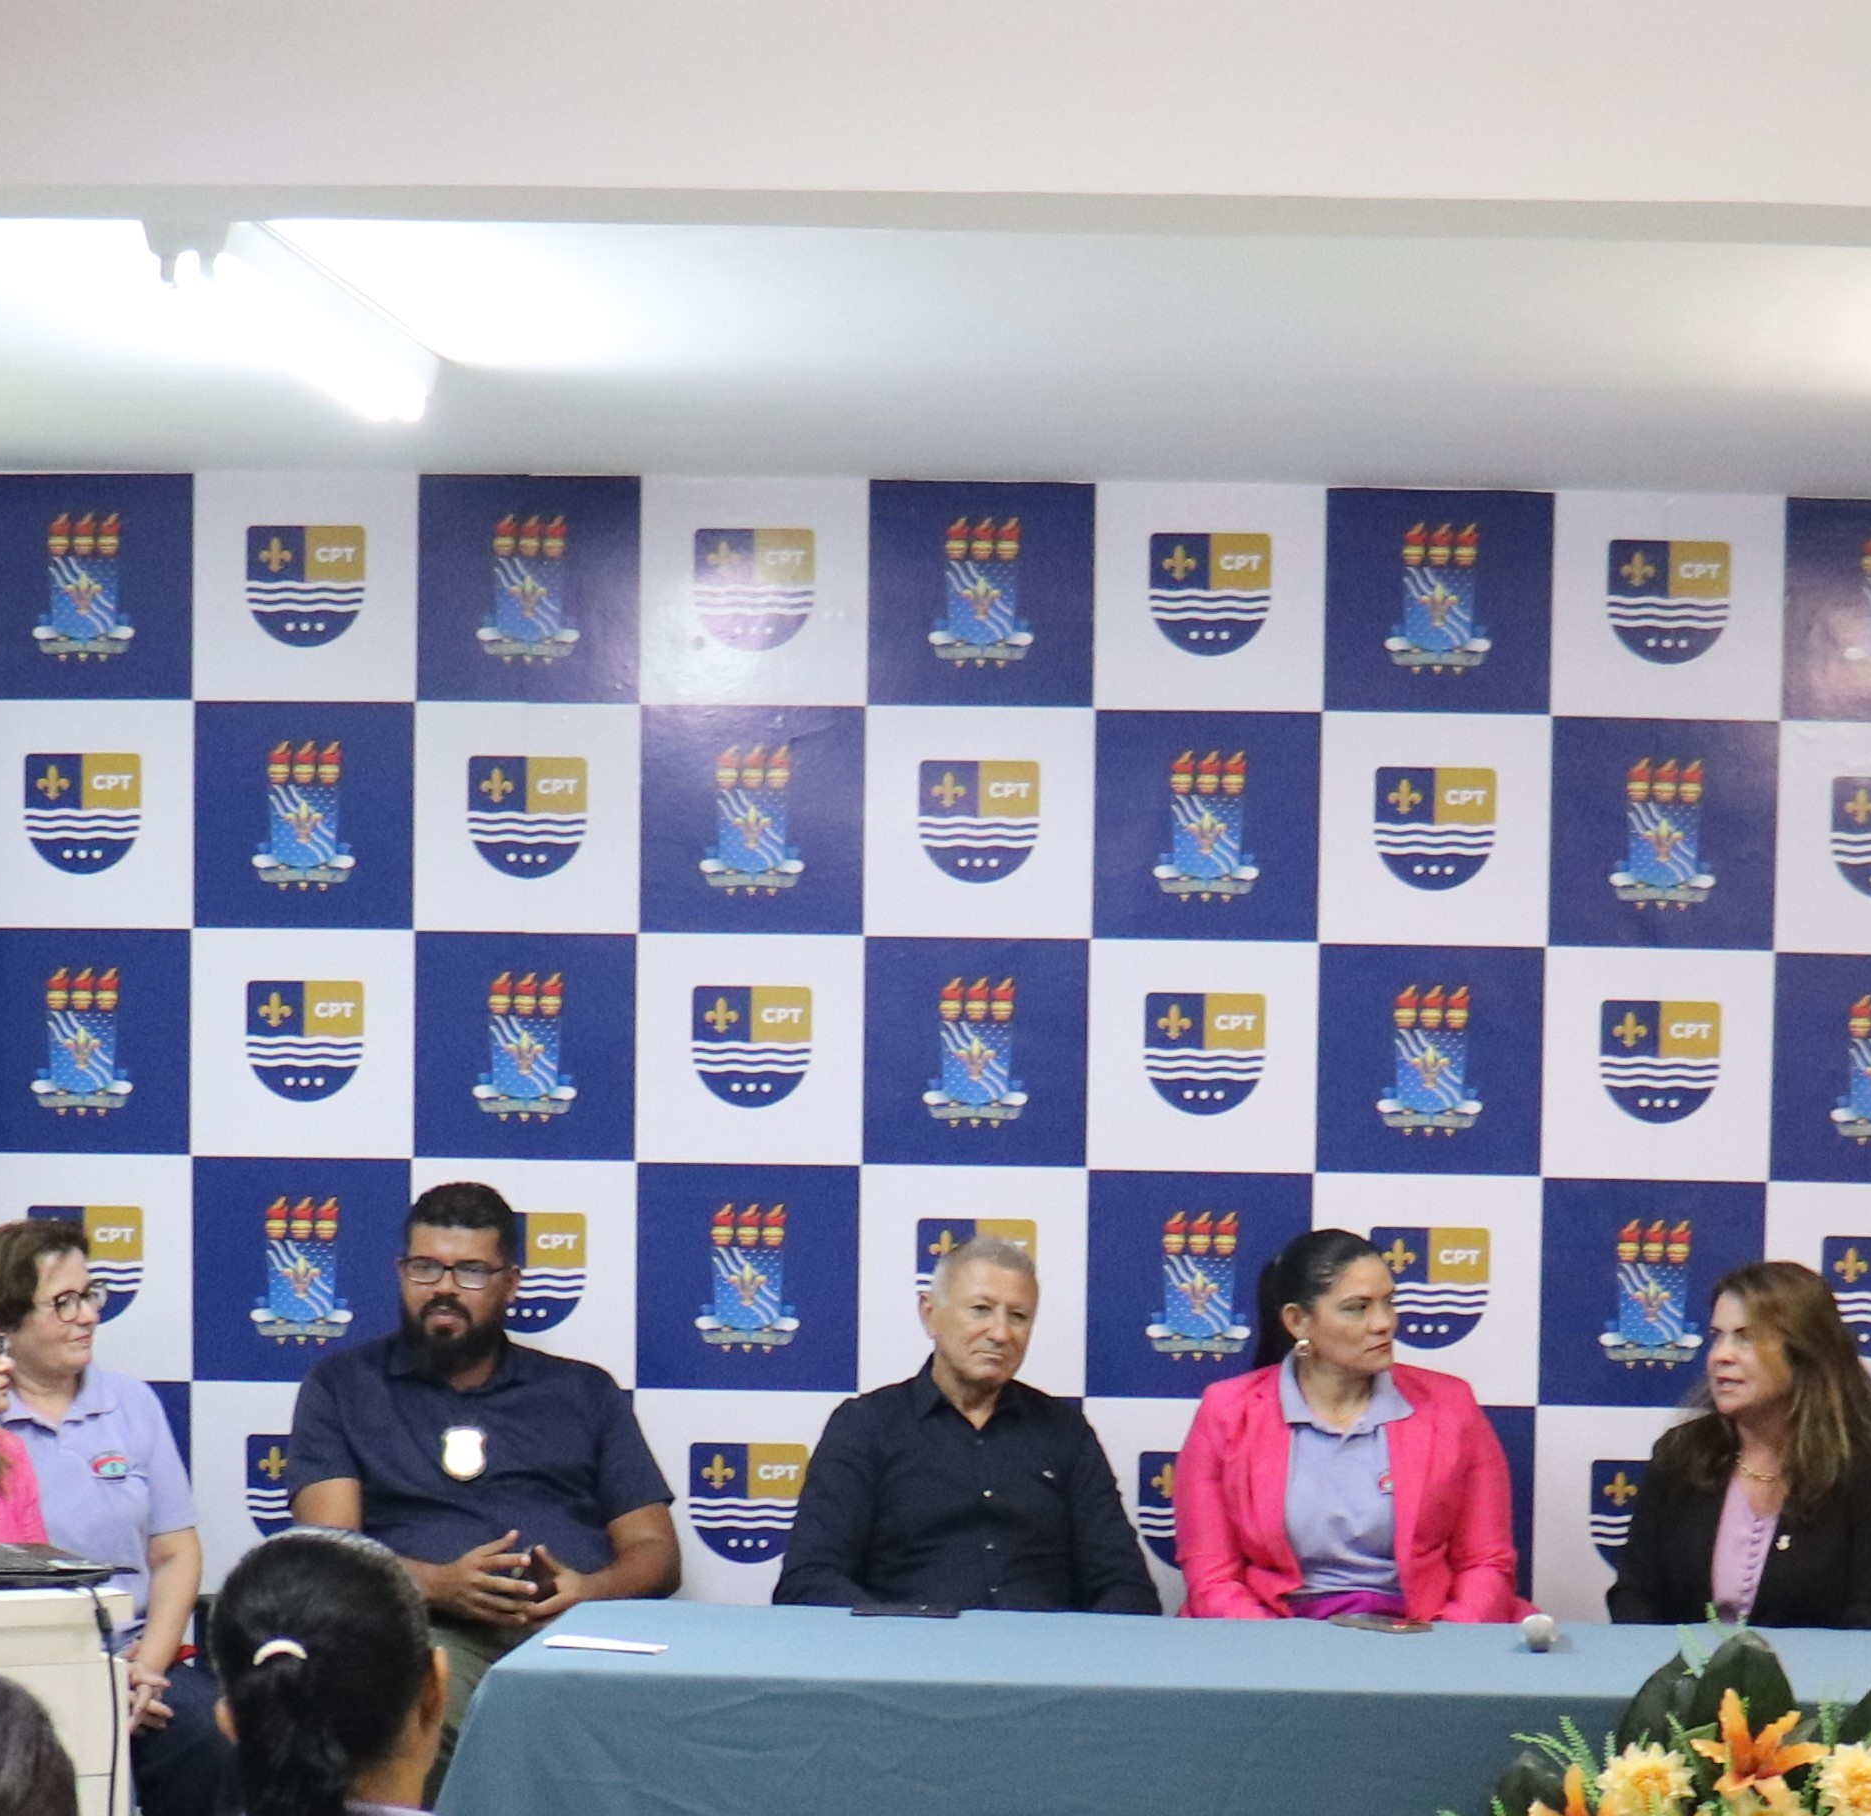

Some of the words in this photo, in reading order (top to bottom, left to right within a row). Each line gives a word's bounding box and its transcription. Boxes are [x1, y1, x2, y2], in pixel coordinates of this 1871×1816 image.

[315, 546, 356, 562] CPT
[764, 550, 804, 566] CPT
[1220, 554, 1262, 570] CPT
[1679, 562, 1721, 578] CPT
[92, 774, 133, 790] CPT
[537, 777, 578, 794] CPT
[988, 781, 1030, 797] CPT
[1445, 788, 1487, 805] CPT
[314, 1001, 355, 1017] CPT
[761, 1007, 803, 1023] CPT
[1215, 1014, 1256, 1030] CPT
[1670, 1022, 1712, 1038] CPT
[94, 1226, 135, 1242] CPT
[537, 1233, 578, 1249] CPT
[1439, 1248, 1481, 1264] CPT
[758, 1464, 799, 1480] CPT
